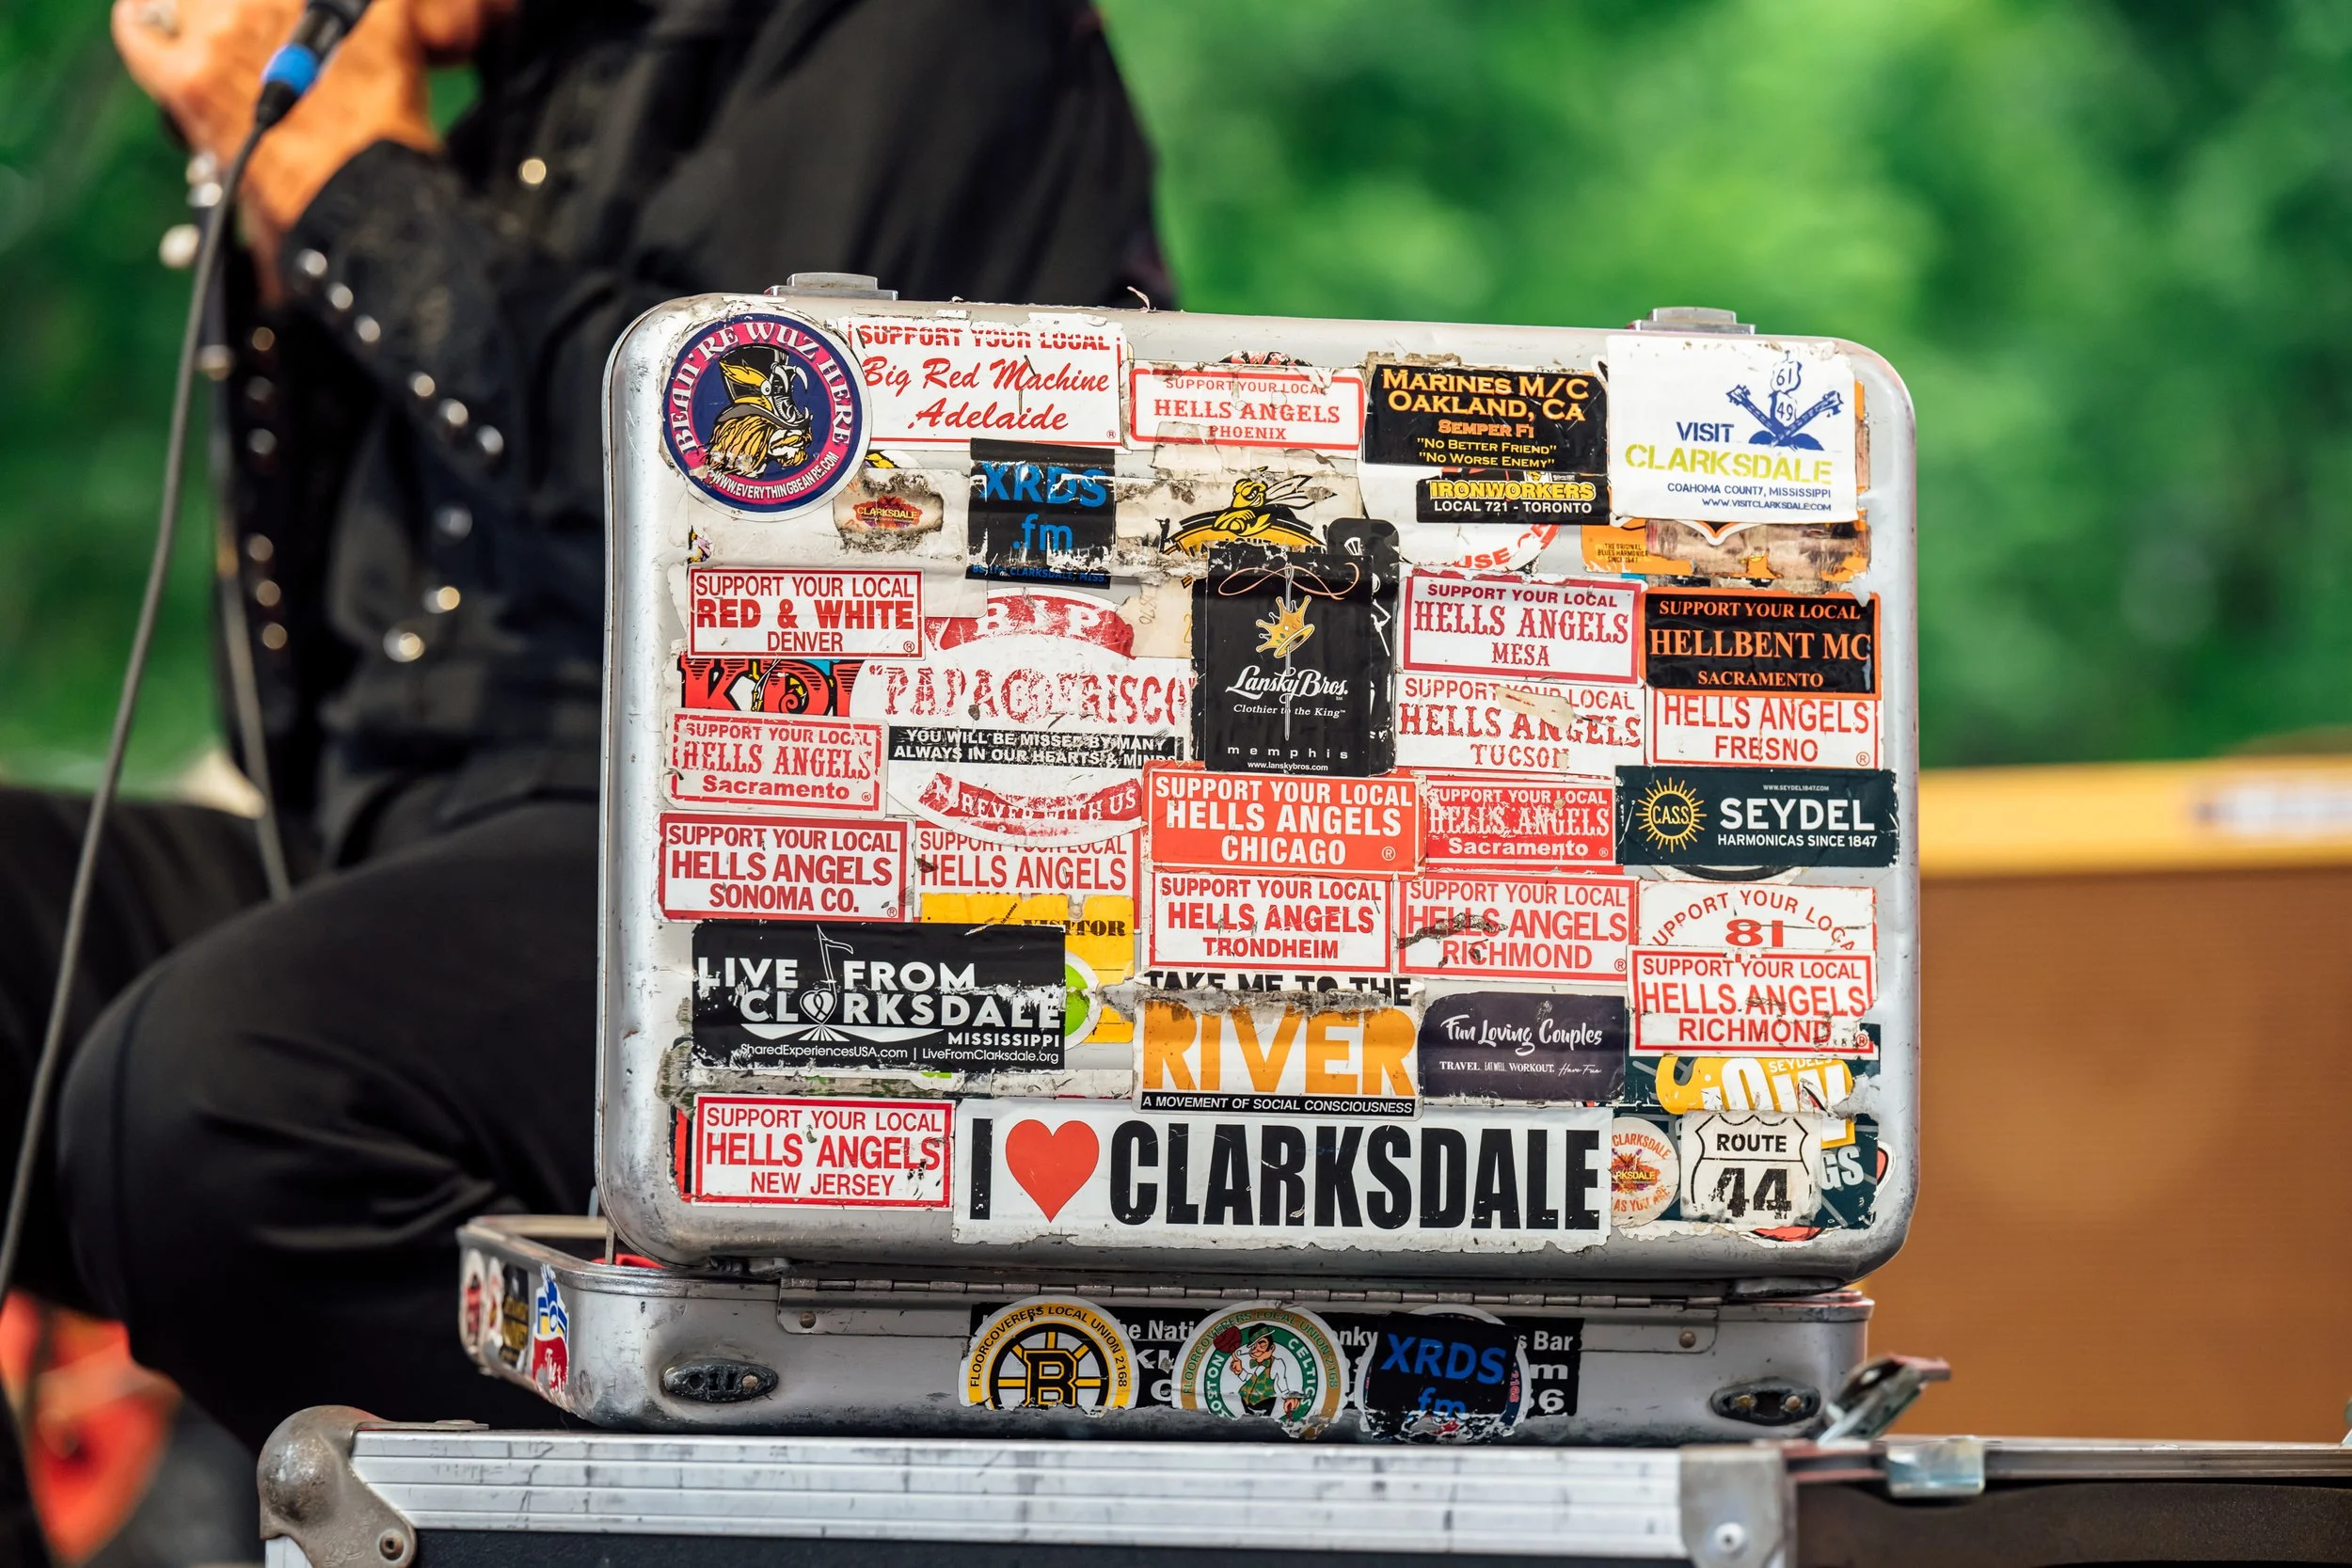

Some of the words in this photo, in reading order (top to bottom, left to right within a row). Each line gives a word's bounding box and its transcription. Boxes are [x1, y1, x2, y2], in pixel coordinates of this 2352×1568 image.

[862, 356, 911, 396] Big
[922, 358, 980, 389] Red
[990, 358, 1109, 391] Machine
[1520, 375, 1589, 399] M/C
[1776, 368, 1792, 385] 61
[817, 356, 853, 446] HERE
[908, 397, 1069, 430] Adelaide
[1776, 403, 1793, 421] 49
[1209, 425, 1287, 440] PHOENIX
[1677, 421, 1734, 442] VISIT
[1626, 444, 1833, 485] CLARKSDALE
[978, 462, 1108, 508] XRDS
[1429, 480, 1596, 501] IRONWORKERS
[1667, 483, 1721, 494] COAHOMA
[1724, 485, 1767, 497] COUNTY,
[1770, 487, 1831, 499] MISSISSIPPI
[856, 507, 918, 520] CLARKSDALE
[1434, 500, 1481, 512] LOCAL
[1485, 501, 1508, 512] 721
[1522, 502, 1592, 514] TORONTO
[1702, 499, 1831, 512] WWW.VISITCLARKSDALE.COM
[695, 576, 784, 596] SUPPORT
[792, 577, 843, 597] YOUR
[852, 578, 914, 597] LOCAL
[697, 599, 761, 627] RED
[777, 598, 798, 628] &
[814, 600, 914, 629] WHITE
[1414, 601, 1505, 636] HELLS
[1517, 609, 1629, 643] ANGELS
[768, 631, 843, 651] DENVER
[1649, 629, 1815, 658] HELLBENT
[1823, 634, 1870, 660] MC
[1491, 642, 1549, 666] MESA
[1698, 671, 1823, 688] SACRAMENTO
[1234, 705, 1277, 714] Clothier
[1295, 706, 1311, 715] the
[1399, 703, 1501, 738] HELLS
[1509, 712, 1641, 747] ANGELS
[906, 729, 942, 743] YOU
[947, 731, 988, 745] WILL
[993, 734, 1015, 746] BE
[1118, 737, 1166, 751] MANY
[1715, 736, 1819, 762] FRESNO
[682, 740, 763, 774] HELLS
[772, 745, 871, 780] ANGELS
[894, 746, 961, 759] ALWAYS
[968, 748, 986, 760] IN
[992, 749, 1030, 763] OUR
[1033, 751, 1100, 765] HEARTS
[1248, 761, 1327, 770] www.lanskybros.com
[703, 775, 849, 800] Sacramento
[1110, 788, 1136, 815] US
[1167, 800, 1264, 832] HELLS
[1277, 805, 1401, 836] ANGELS
[1429, 805, 1504, 835] HELLS
[1514, 807, 1610, 837] ANGELS
[1720, 798, 1875, 831] SEYDEL
[1221, 835, 1345, 864] CHICAGO
[1449, 837, 1588, 856] Sacramento
[1718, 834, 1804, 847] HARMONICAS
[1807, 835, 1845, 847] SINCE
[1848, 835, 1877, 847] 1847
[672, 850, 767, 881] HELLS
[772, 854, 892, 886] ANGELS
[921, 854, 1007, 887] HELLS
[1016, 856, 1126, 890] ANGELS
[709, 883, 815, 911] SONOMA
[821, 888, 859, 912] CO.
[1162, 878, 1250, 897] SUPPORT
[1258, 880, 1312, 899] YOUR
[1319, 881, 1381, 900] LOCAL
[1410, 880, 1499, 902] SUPPORT
[1506, 884, 1557, 904] YOUR
[1565, 886, 1625, 907] LOCAL
[1740, 890, 1798, 913] YOUR
[1203, 937, 1338, 958] TRONDHEIM
[1442, 941, 1592, 969] RICHMOND
[697, 957, 799, 990] LIVE
[844, 960, 975, 992] FROM
[1642, 982, 1736, 1014] HELLS
[1746, 985, 1867, 1017] ANGELS
[947, 1033, 1060, 1048] MISSISSIPPI
[1440, 1014, 1475, 1040] Fun
[1478, 1020, 1534, 1056] Loving
[1539, 1019, 1602, 1051] Couples
[1679, 1018, 1832, 1043] RICHMOND
[740, 1042, 908, 1059] SharedExperiencesUSA.com
[923, 1047, 1059, 1063] LiveFromClarksdale.org
[1143, 1001, 1416, 1096] RIVER
[1558, 1063, 1582, 1076] Have
[1143, 1097, 1152, 1106] A
[1156, 1098, 1228, 1109] MOVEMENT
[1232, 1100, 1250, 1109] OF
[1254, 1100, 1300, 1110] SOCIAL
[1304, 1101, 1412, 1113] CONSCIOUSNESS
[707, 1132, 803, 1166] HELLS
[817, 1135, 940, 1170] ANGELS
[1613, 1133, 1671, 1159] CLARKSDALE
[1717, 1133, 1787, 1152] ROUTE
[752, 1172, 802, 1194] NEW
[811, 1174, 895, 1196] JERSEY
[970, 1117, 993, 1220] I
[1110, 1120, 1599, 1230] CLARKSDALE
[1613, 1199, 1627, 1212] AS
[1708, 1168, 1792, 1220] 44
[970, 1306, 1043, 1386] FLOORCOVERERS
[1048, 1307, 1088, 1323] LOCAL
[1091, 1319, 1120, 1353] UNION
[1115, 1355, 1128, 1386] 2168
[1183, 1312, 1251, 1394] FLOORCOVERERS
[1257, 1311, 1295, 1325] LOCAL
[1300, 1319, 1329, 1354] UNION
[1534, 1331, 1573, 1351] Bar
[1288, 1338, 1316, 1406] CELTICS
[1381, 1334, 1506, 1385] XRDS
